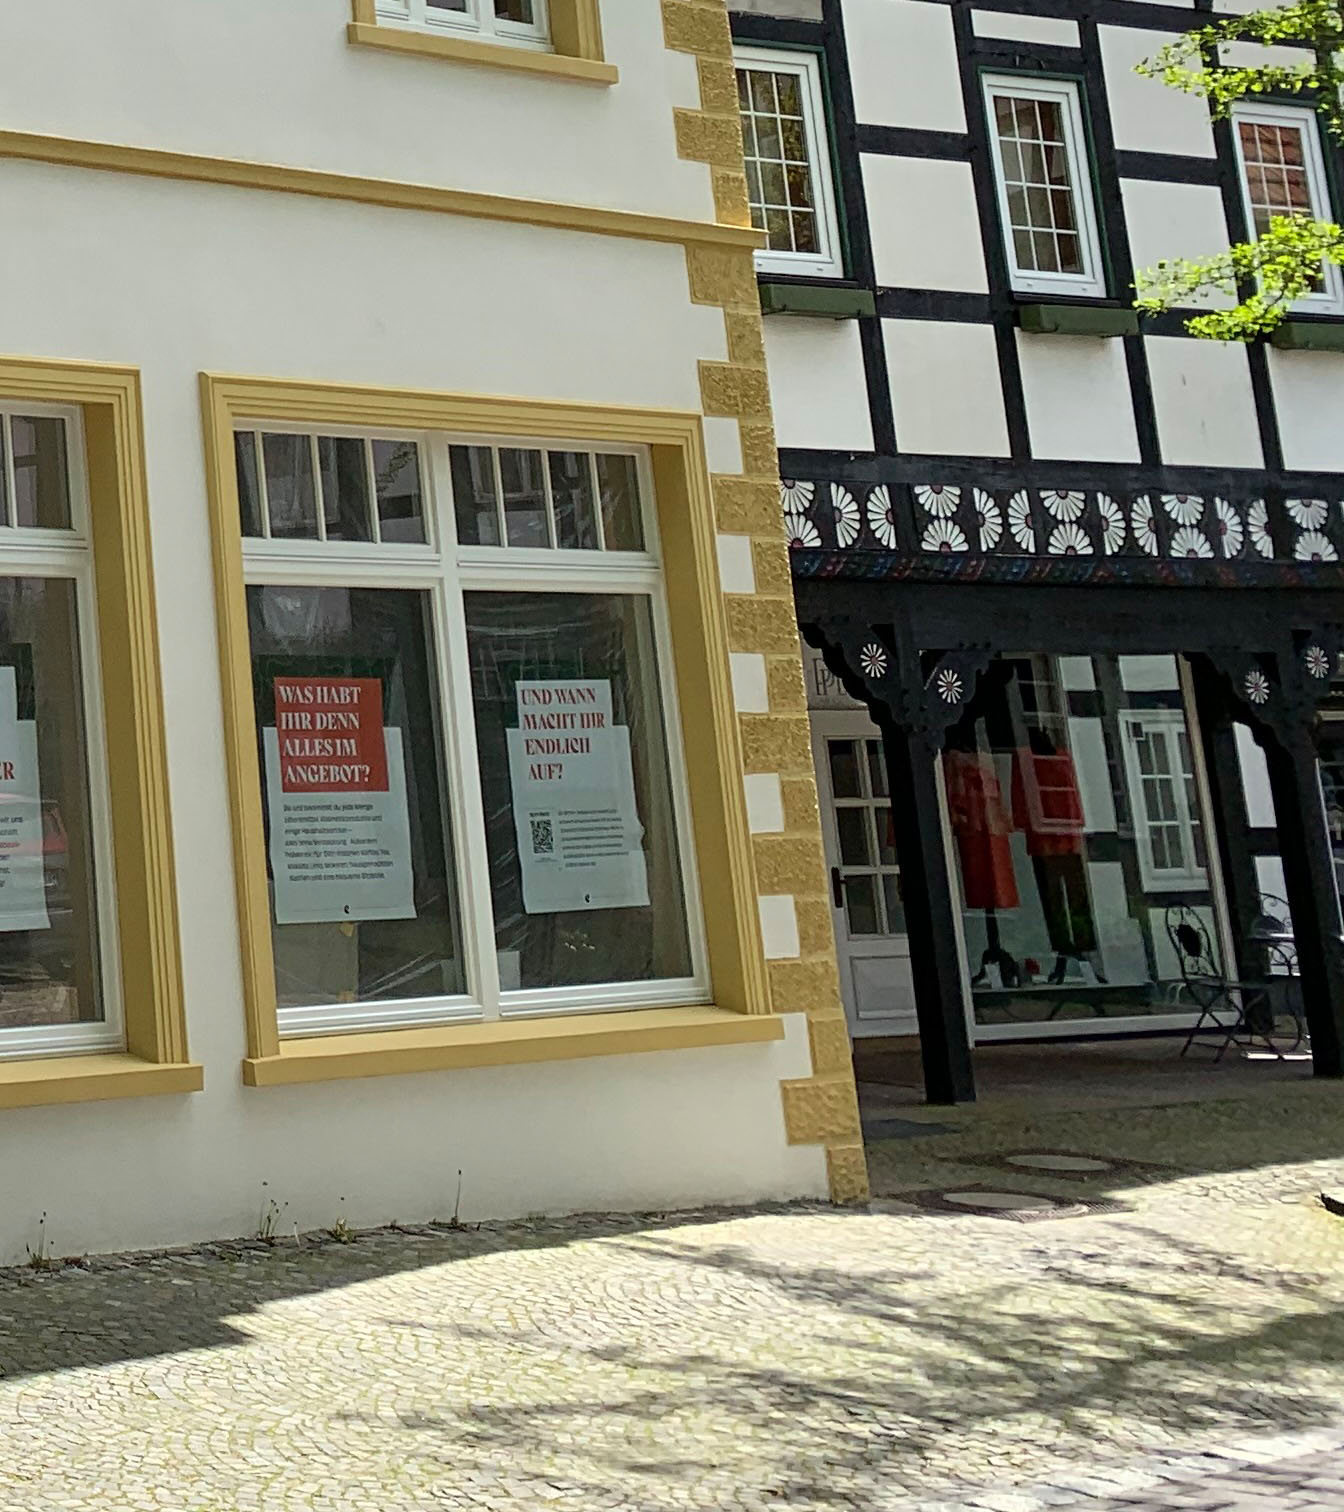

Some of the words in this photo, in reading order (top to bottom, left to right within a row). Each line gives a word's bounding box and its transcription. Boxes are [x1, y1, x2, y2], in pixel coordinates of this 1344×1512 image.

[279, 685, 314, 704] WAS
[315, 686, 362, 704] HABT
[520, 688, 552, 705] UND
[554, 687, 596, 705] WANN
[280, 712, 313, 730] IHR
[315, 711, 360, 730] DENN
[523, 712, 577, 730] MACHT
[579, 712, 606, 729] IHR
[282, 738, 334, 757] ALLES
[335, 738, 358, 757] IM
[525, 737, 591, 755] ENDLICH
[285, 764, 371, 783] ANGEBOT?
[528, 763, 563, 781] AUF?
